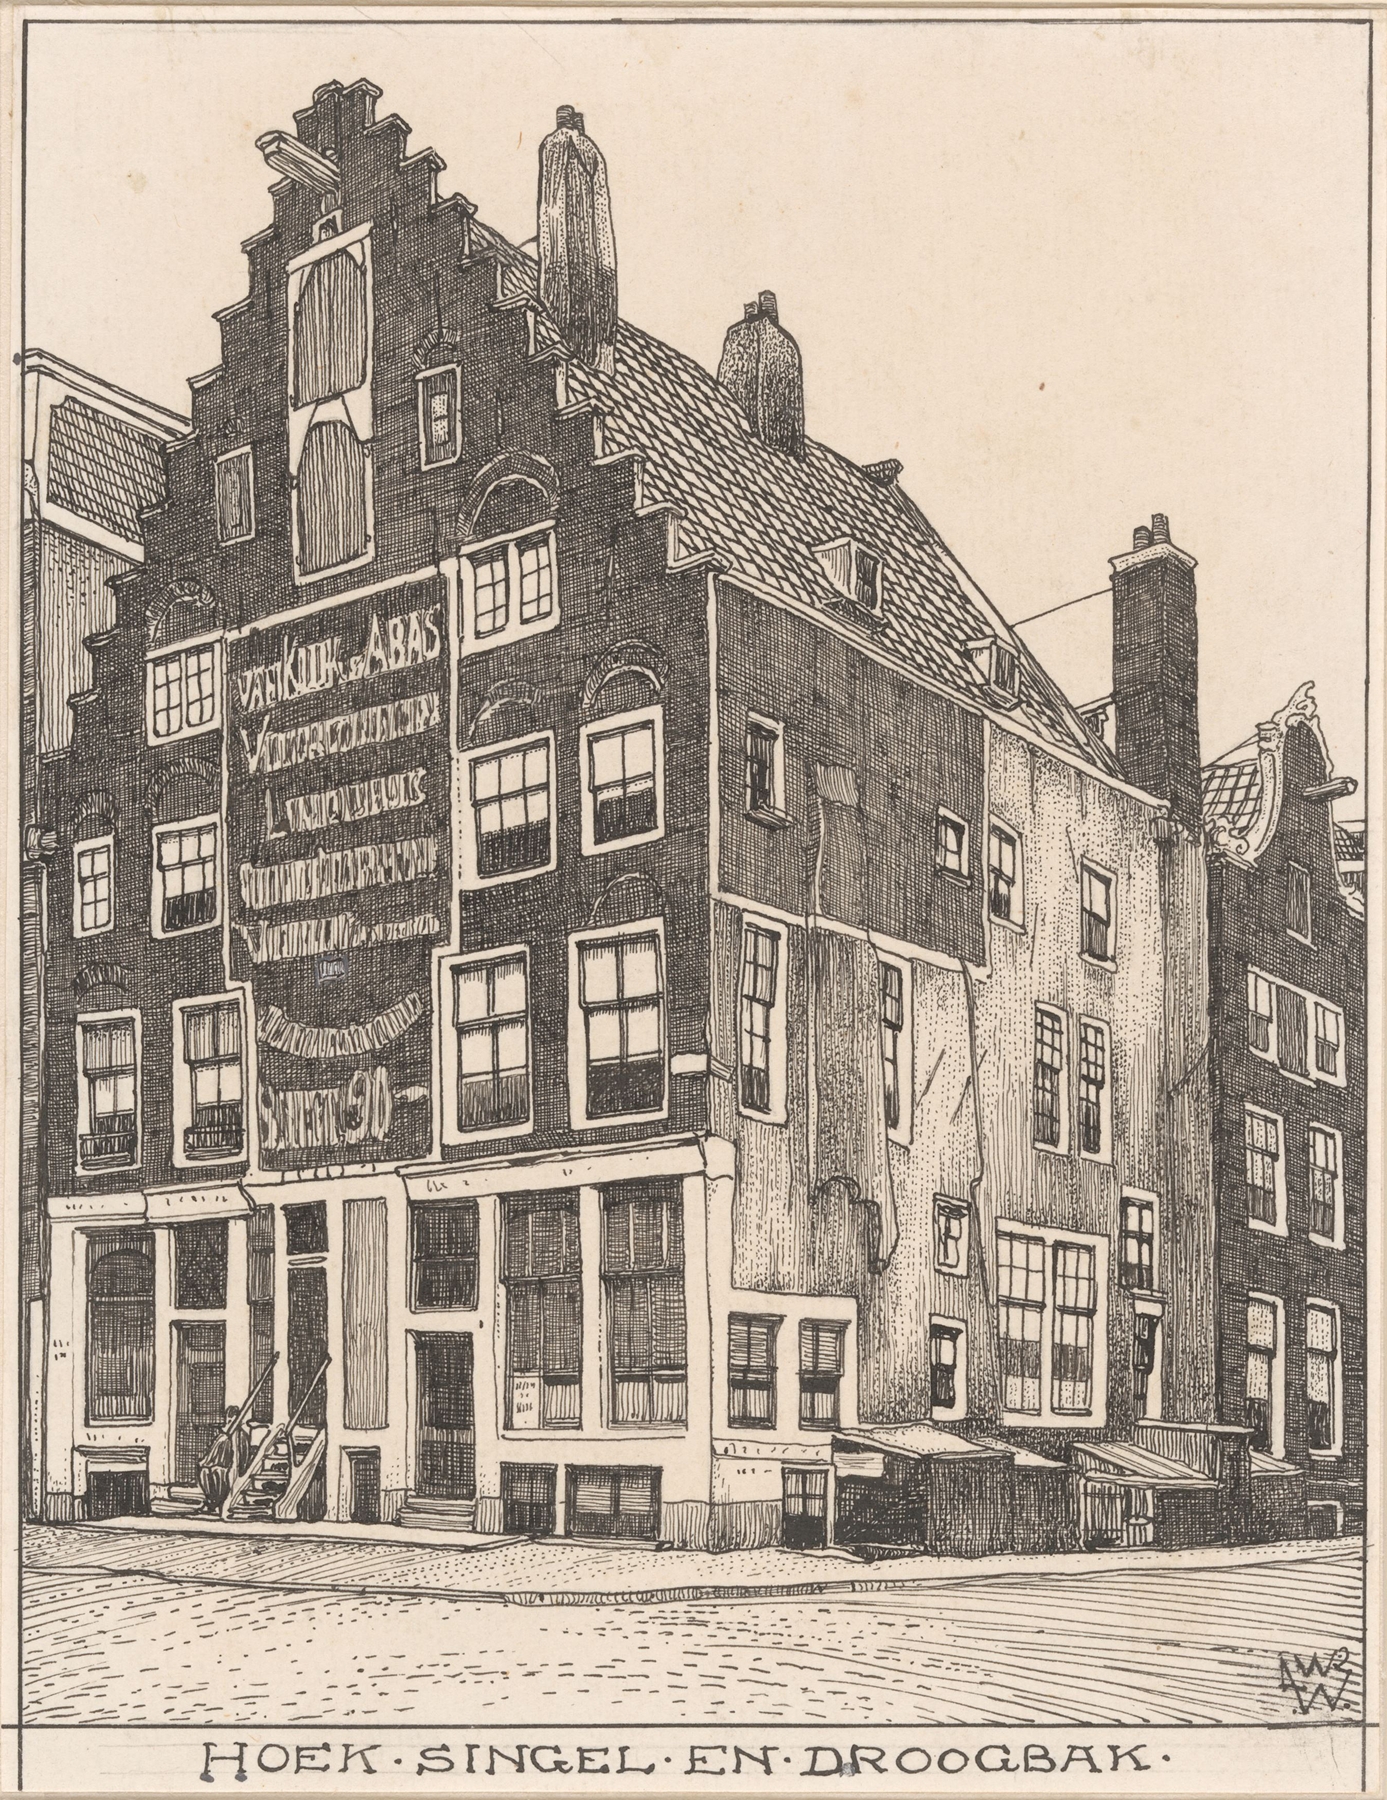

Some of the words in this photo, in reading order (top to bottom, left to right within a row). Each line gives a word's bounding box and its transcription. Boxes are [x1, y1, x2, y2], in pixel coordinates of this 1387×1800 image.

[198, 1742, 382, 1783] HOEK
[416, 1743, 656, 1776] SINGEL
[684, 1745, 779, 1776] EN
[799, 1744, 1151, 1777] DROOGBAK
